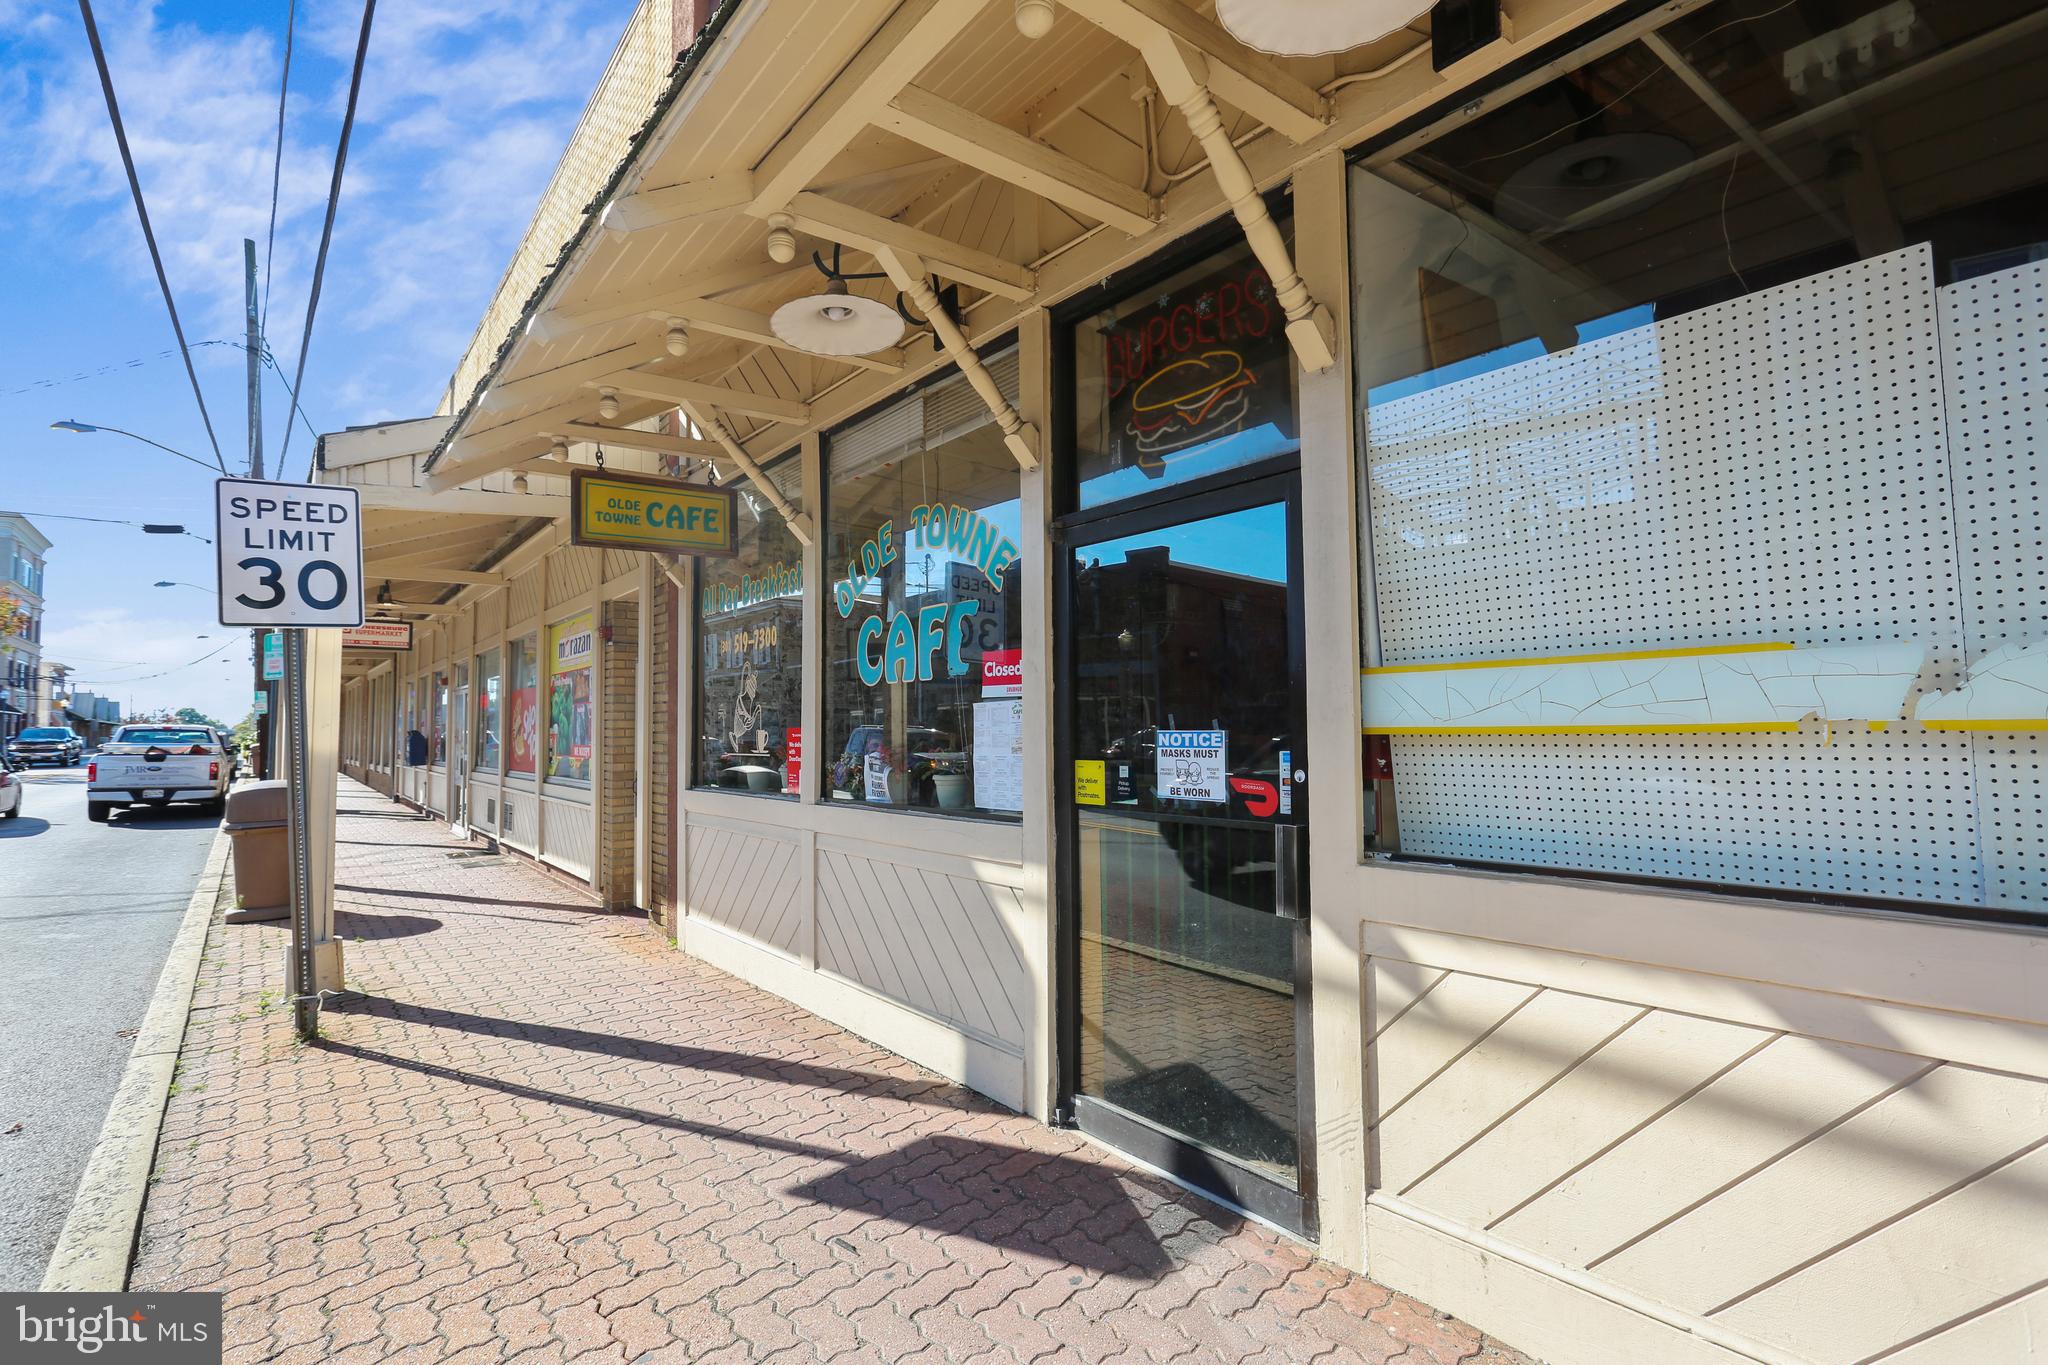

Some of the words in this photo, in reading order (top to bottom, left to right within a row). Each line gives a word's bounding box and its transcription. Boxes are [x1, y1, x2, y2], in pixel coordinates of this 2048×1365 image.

[1106, 268, 1269, 398] BURGERS
[230, 497, 348, 524] SPEED
[607, 498, 641, 511] OLDE
[595, 511, 641, 525] TOWNE
[646, 502, 720, 533] CAFE
[244, 527, 336, 552] LIMIT
[836, 519, 897, 618] OLDE
[910, 503, 1021, 592] TOWNE
[235, 557, 348, 610] 30
[702, 583, 717, 618] All
[719, 582, 739, 618] Day
[741, 560, 802, 607] Breakfast
[356, 629, 402, 637] SUPERMARKET
[984, 659, 1023, 678] Closed
[1158, 732, 1222, 748] NOTICE
[1161, 748, 1191, 758] MASKS
[1193, 749, 1219, 759] MUST
[1170, 787, 1182, 796] BE
[1184, 787, 1211, 798] WORN
